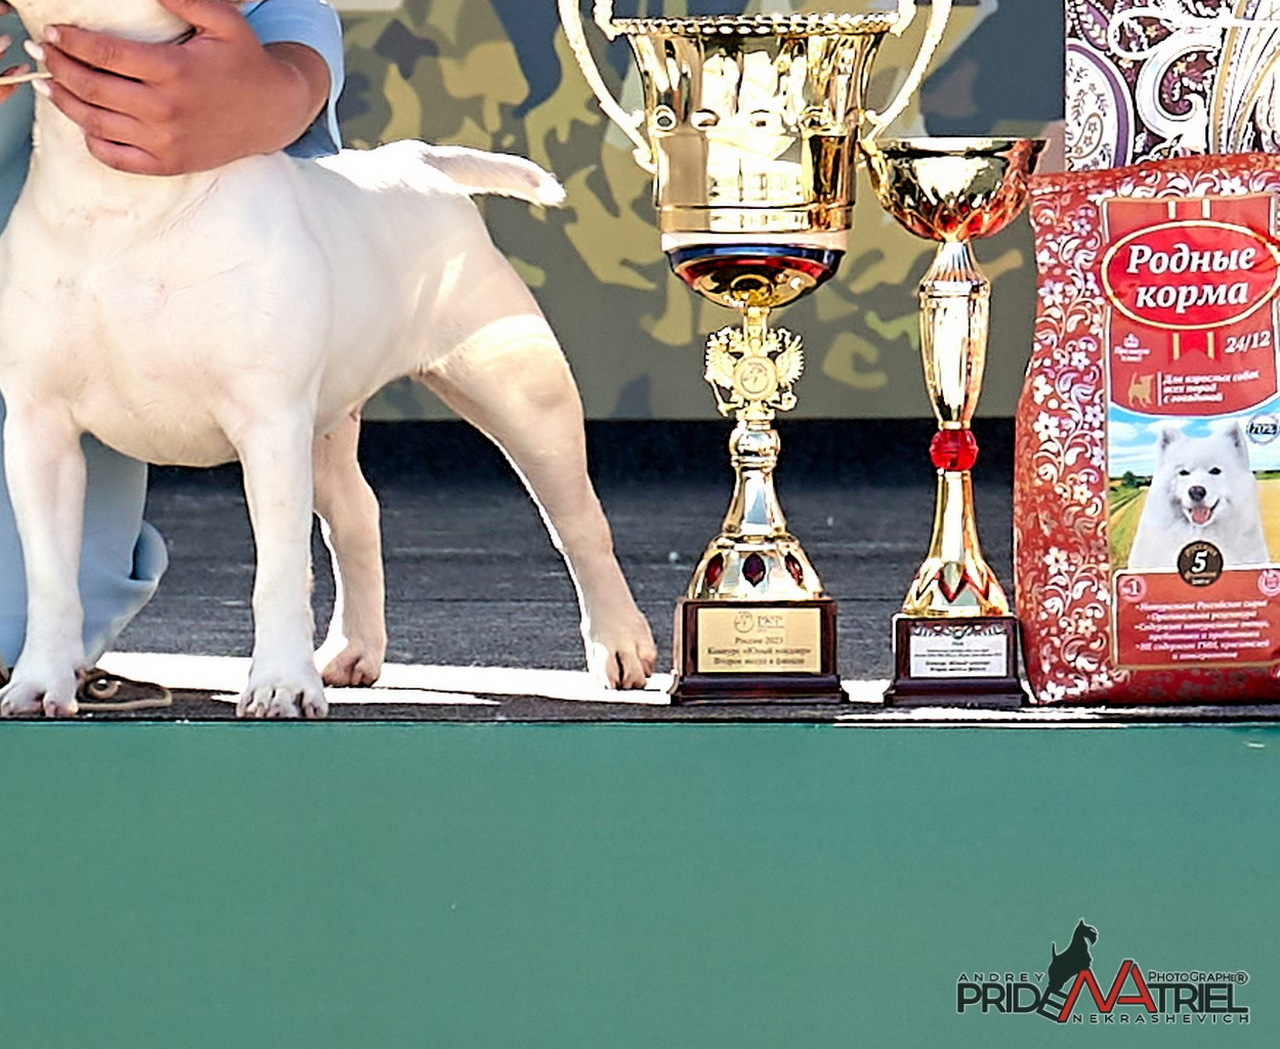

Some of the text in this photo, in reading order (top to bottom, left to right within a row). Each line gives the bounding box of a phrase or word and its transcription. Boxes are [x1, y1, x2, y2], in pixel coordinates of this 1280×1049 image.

[1126, 243, 1256, 274] Родные
[1136, 282, 1249, 314] корма
[1224, 331, 1271, 353] 24/12
[1191, 550, 1208, 574] 5
